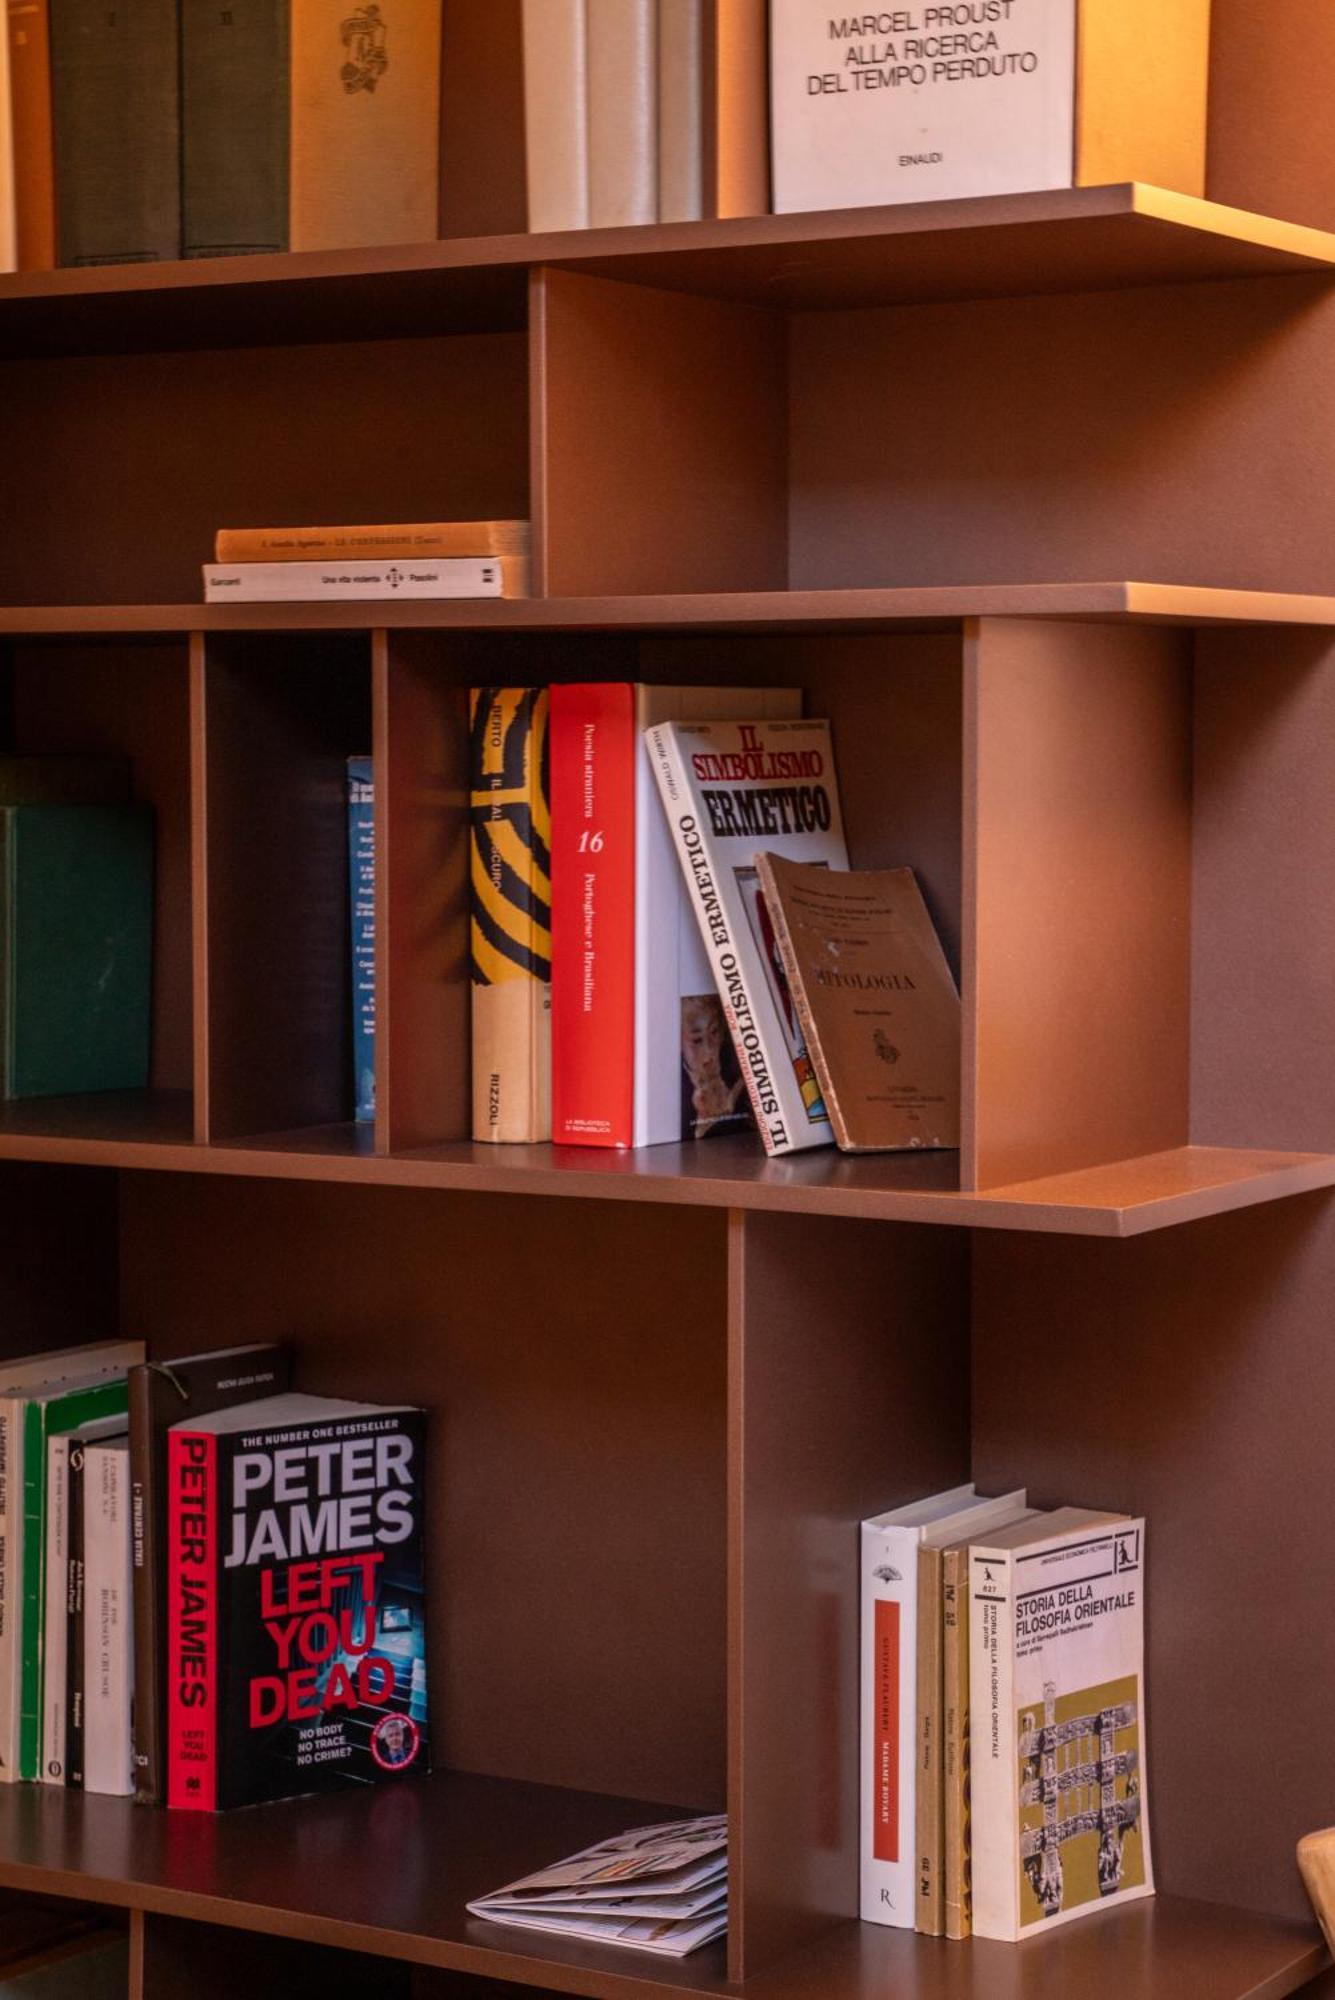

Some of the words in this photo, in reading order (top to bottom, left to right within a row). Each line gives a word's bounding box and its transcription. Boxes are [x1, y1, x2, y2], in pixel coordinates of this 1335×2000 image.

[828, 12, 918, 40] MARCEL
[924, 0, 1016, 29] PROUST
[844, 43, 898, 66] ALLA
[904, 31, 999, 60] RICERCA
[807, 73, 848, 95] DEL
[852, 64, 927, 90] TEMPO
[932, 52, 1038, 82] PERDUTO
[898, 152, 944, 167] EINAUDI
[492, 705, 502, 747] BERTO
[584, 724, 595, 761] Poesia
[738, 725, 764, 753] IL
[691, 750, 824, 781] SIMBOLISMO
[584, 765, 595, 819] straniera
[701, 785, 832, 837] ERMETICO
[578, 831, 604, 851] 16
[679, 814, 729, 947] ERMETICO
[583, 873, 595, 938] Portoghese
[584, 953, 595, 1012] Brasiliana
[720, 952, 778, 1115] SIMBOLISMO
[489, 1074, 500, 1126] RIZZOLI
[768, 1118, 789, 1148] IL
[241, 1436, 263, 1448] THE
[265, 1428, 310, 1446] NUMBER
[312, 1427, 333, 1439] ONE
[336, 1419, 399, 1436] BESTSELLER
[232, 1434, 415, 1509] PETER
[134, 1497, 143, 1538] CENTRALE
[180, 1437, 207, 1564] PETER
[223, 1489, 415, 1569] JAMES
[134, 1540, 143, 1567] ITALIA
[260, 1551, 385, 1619] LEFT
[1016, 1597, 1055, 1619] STORIA
[1058, 1585, 1093, 1607] DELLA
[102, 1589, 110, 1646] ROBINSON
[1016, 1610, 1071, 1638] FILOSOFIA
[1074, 1591, 1135, 1620] ORIENTALE
[179, 1573, 207, 1707] JAMES
[264, 1605, 377, 1669] YOU
[990, 1641, 998, 1665] DELLA
[250, 1657, 396, 1729] DEAD
[991, 1666, 999, 1711] FILOSOFIA
[182, 1730, 205, 1739] LEFT
[298, 1741, 313, 1753] NO
[315, 1735, 346, 1749] TRACE
[299, 1728, 314, 1741] NO
[316, 1723, 345, 1737] BODY
[991, 1712, 999, 1760] ORIENTALE
[297, 1754, 312, 1766] NO
[314, 1746, 353, 1762] CRIME?
